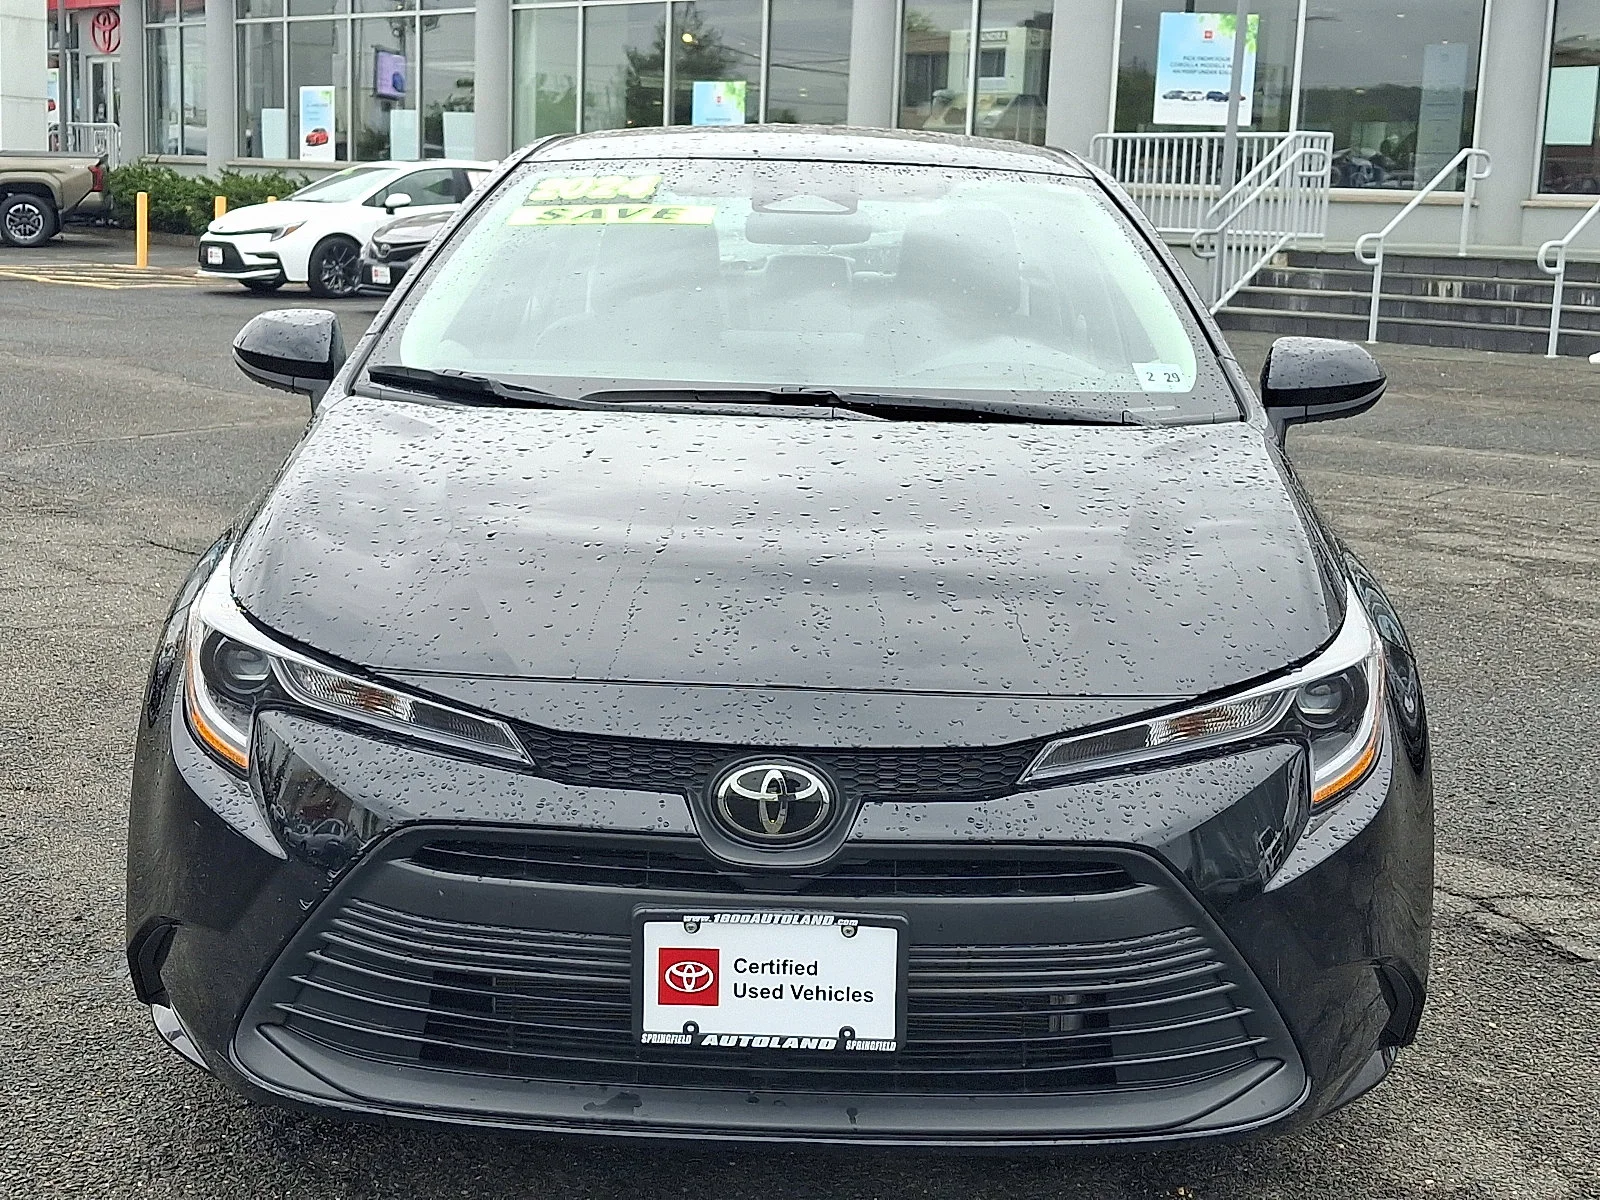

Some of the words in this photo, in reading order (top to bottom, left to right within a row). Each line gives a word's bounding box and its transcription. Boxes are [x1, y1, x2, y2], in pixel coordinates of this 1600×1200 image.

[536, 207, 689, 220] SAVE
[1146, 371, 1156, 382] 2
[1163, 372, 1181, 383] 29
[683, 913, 859, 927] www.1800AUTOLAND.com
[733, 957, 818, 976] Certified
[733, 982, 784, 1000] Used
[790, 984, 874, 1003] Vehicles
[641, 1032, 693, 1045] SPRINGFIELD
[700, 1034, 837, 1050] AUTOLAND
[845, 1039, 897, 1052] SPRINGFIELD
